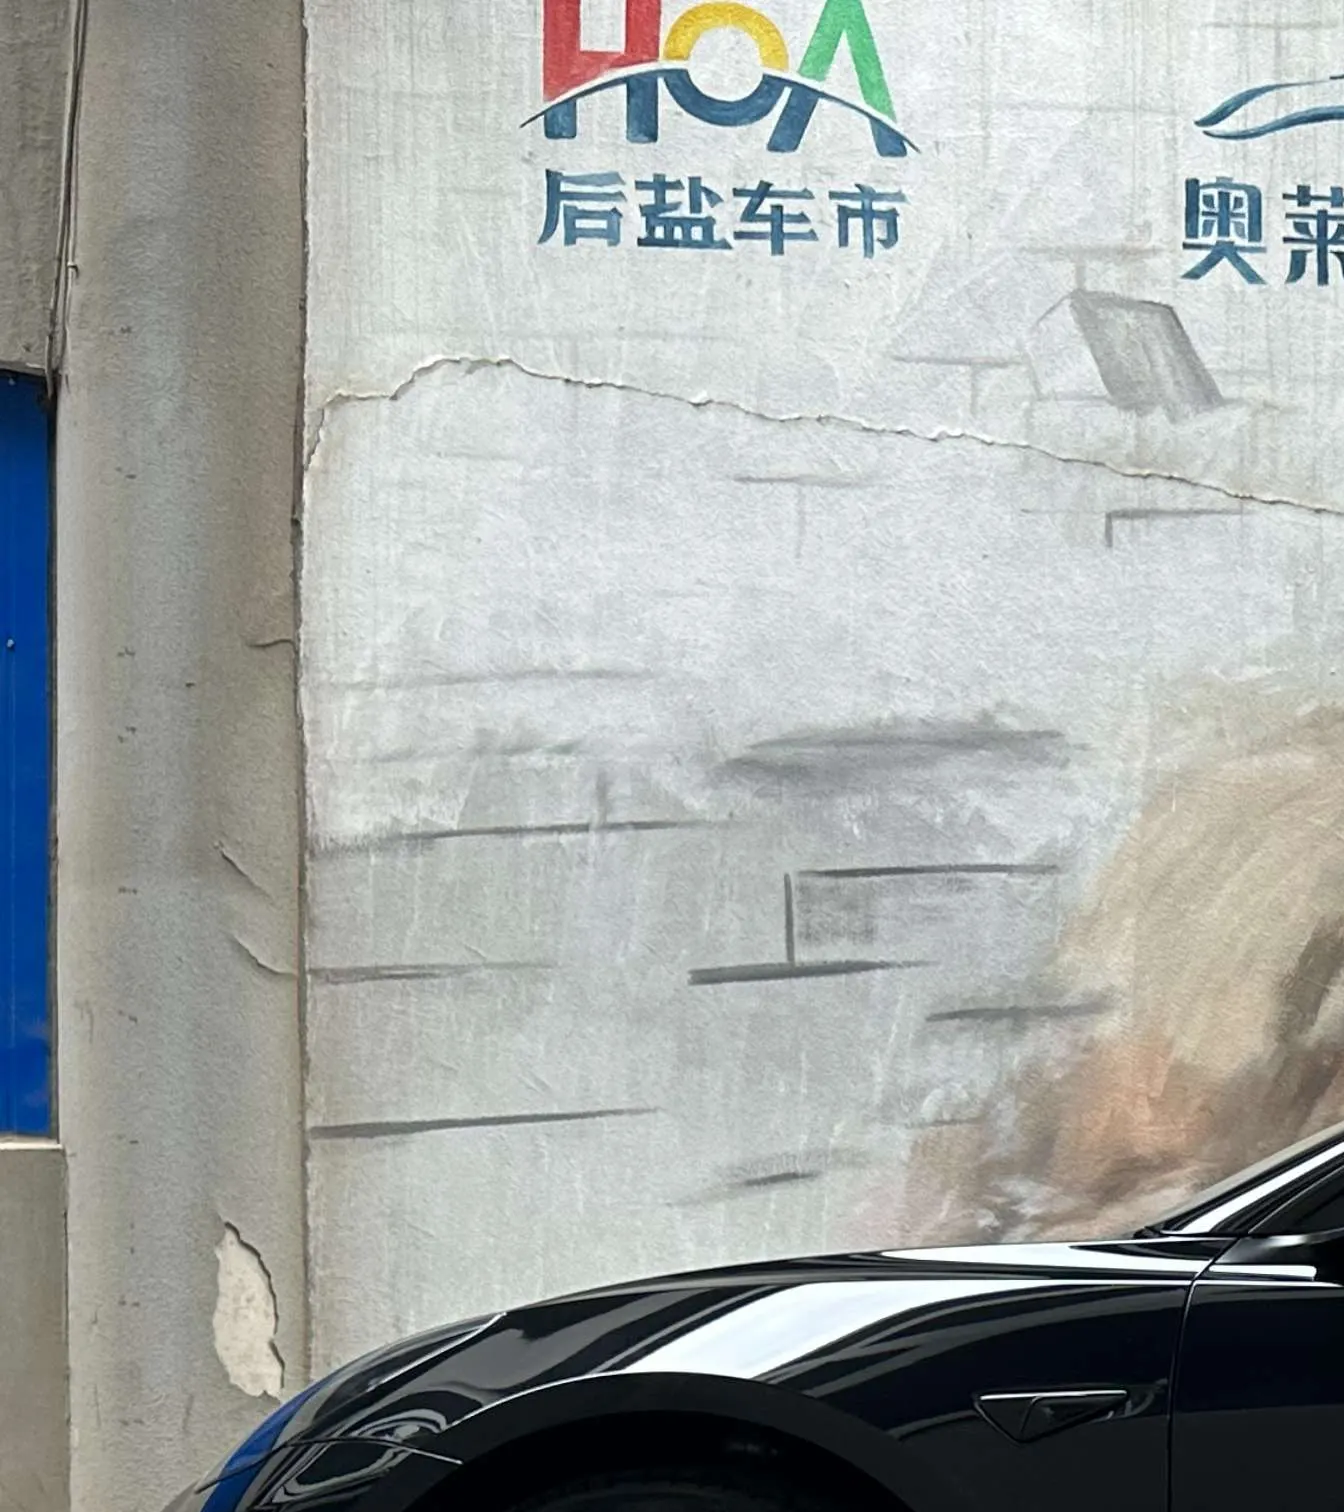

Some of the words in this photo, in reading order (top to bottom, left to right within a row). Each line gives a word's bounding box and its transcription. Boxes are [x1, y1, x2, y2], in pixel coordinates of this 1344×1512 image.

[543, 0, 907, 157] HOA
[537, 168, 911, 258] 后盐车市
